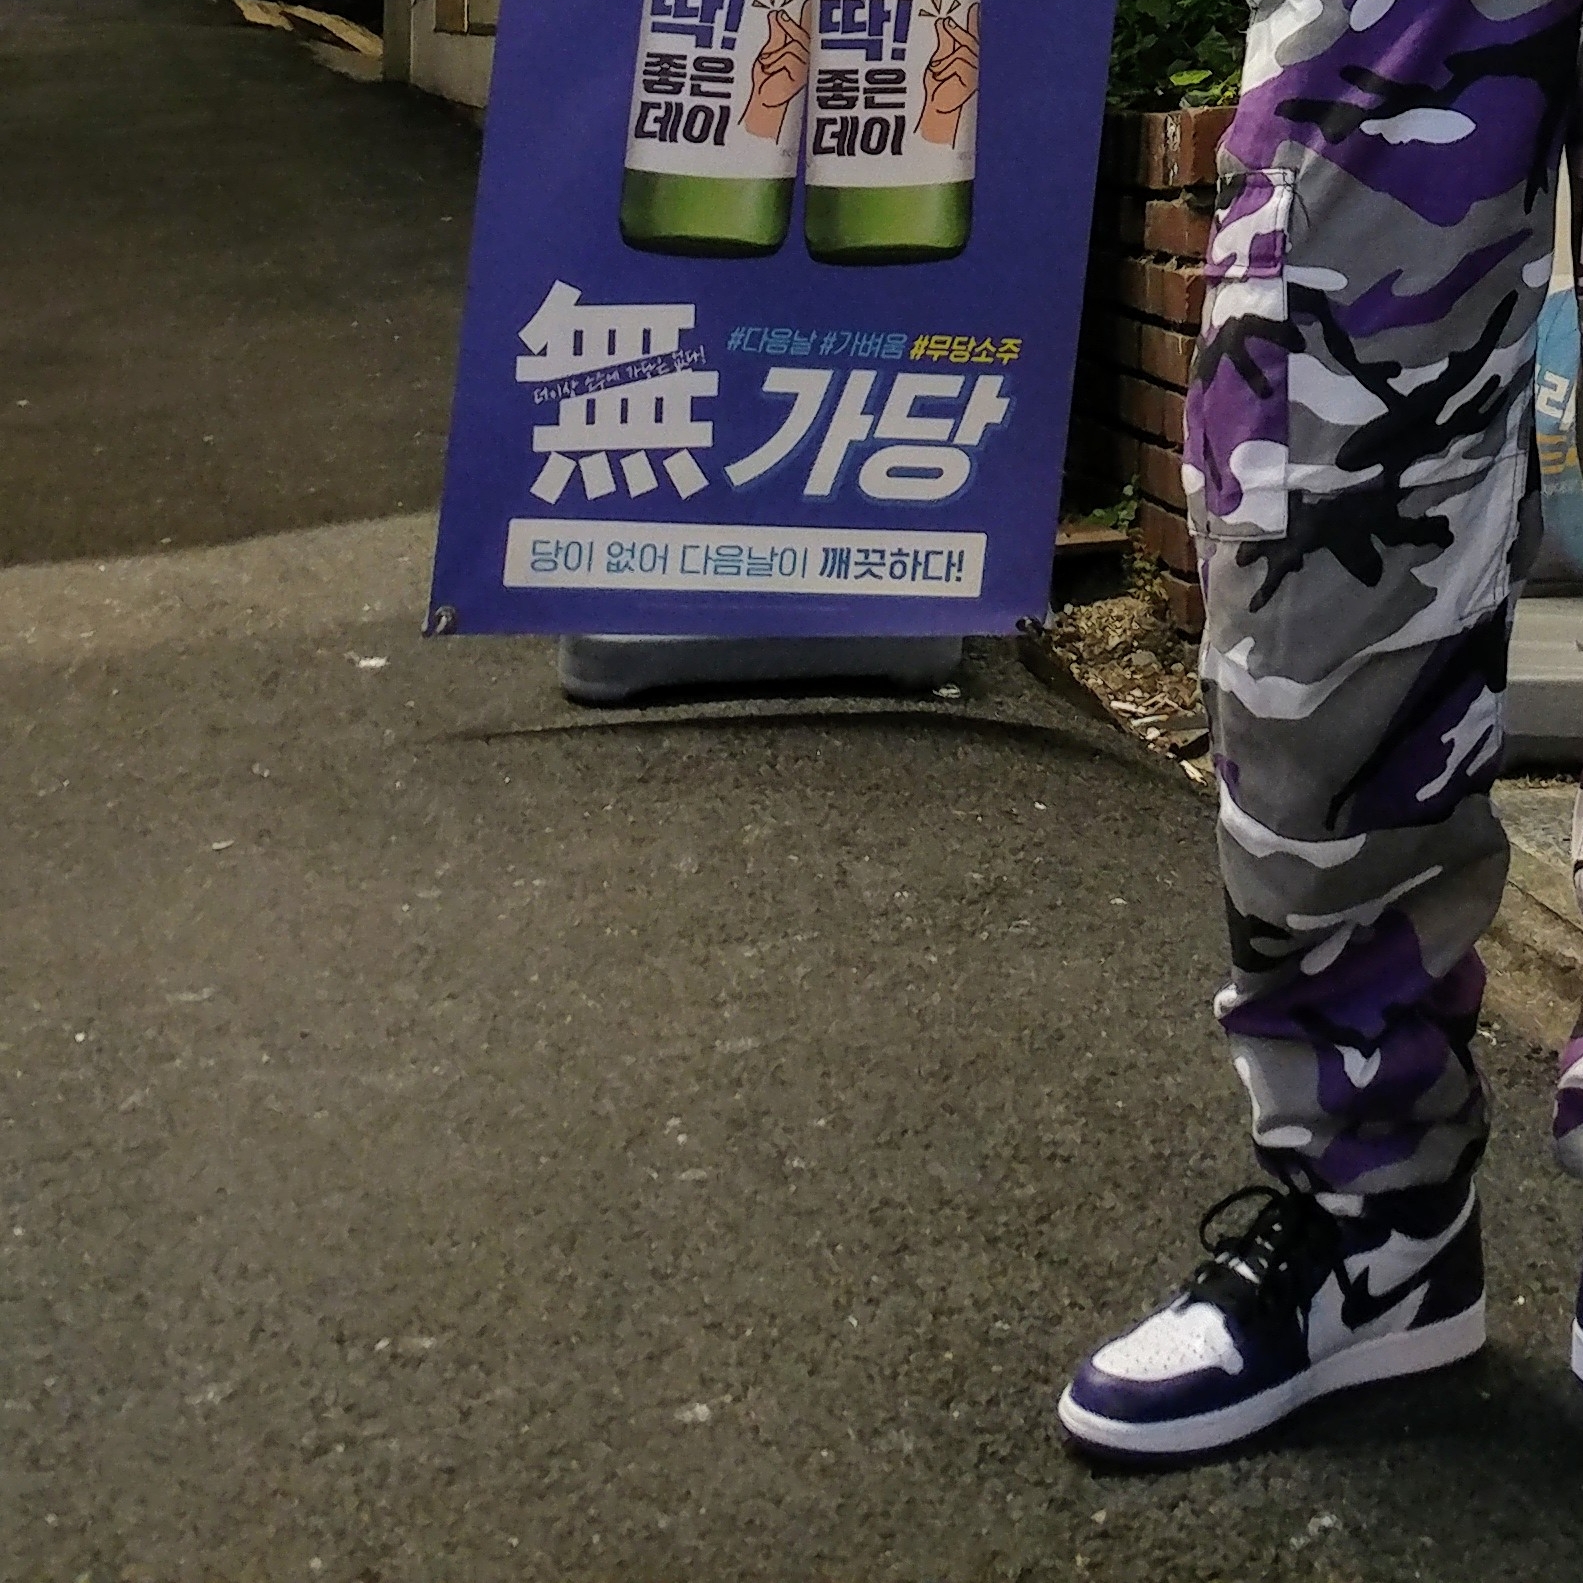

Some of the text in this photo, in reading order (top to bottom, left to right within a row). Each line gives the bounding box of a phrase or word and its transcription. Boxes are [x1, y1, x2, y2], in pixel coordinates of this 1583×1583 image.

[641, 51, 735, 99] 좋은
[815, 68, 907, 111] 좋은
[633, 101, 732, 147] 데이
[812, 114, 907, 157] 데이
[726, 326, 818, 355] #다음날
[909, 333, 1023, 365] #무당소주
[530, 538, 966, 584] 당이 없어 다음날이 깨끗하다!
